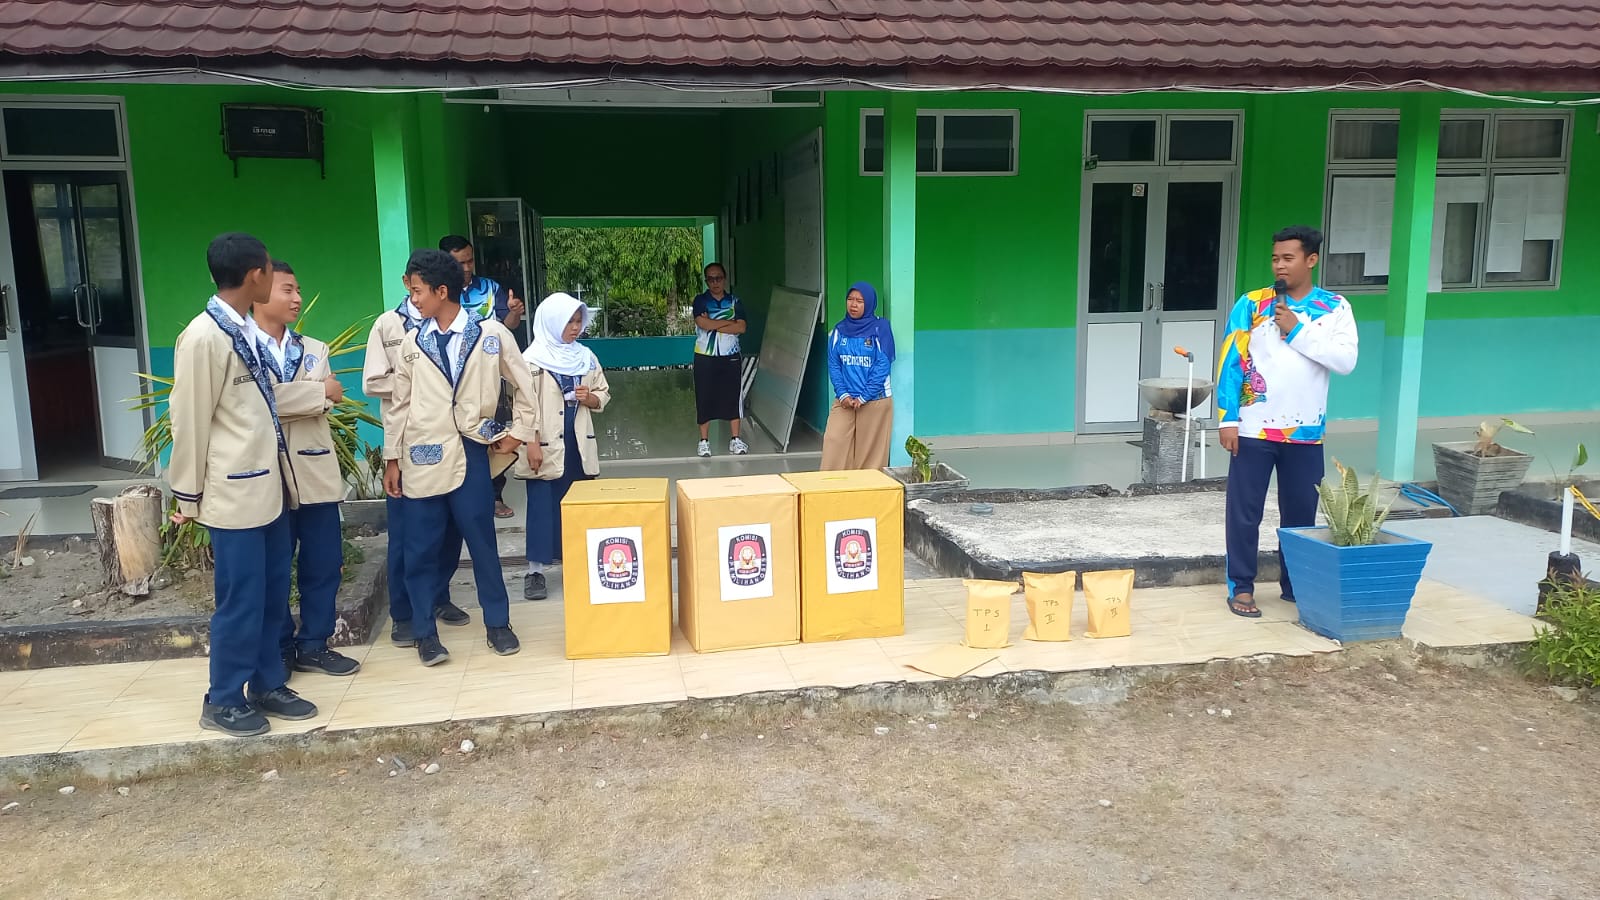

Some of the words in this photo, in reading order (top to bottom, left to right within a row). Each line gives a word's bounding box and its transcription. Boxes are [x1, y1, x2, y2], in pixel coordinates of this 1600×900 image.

[842, 529, 864, 537] KOMISI
[605, 538, 628, 547] KOMISI
[735, 535, 759, 543] KOMISI
[835, 555, 865, 578] PEMILIHAN
[598, 564, 631, 588] PEMILIHAN
[728, 561, 760, 585] PEMILIHAN
[1042, 599, 1060, 607] TPS
[972, 608, 1000, 618] TPS
